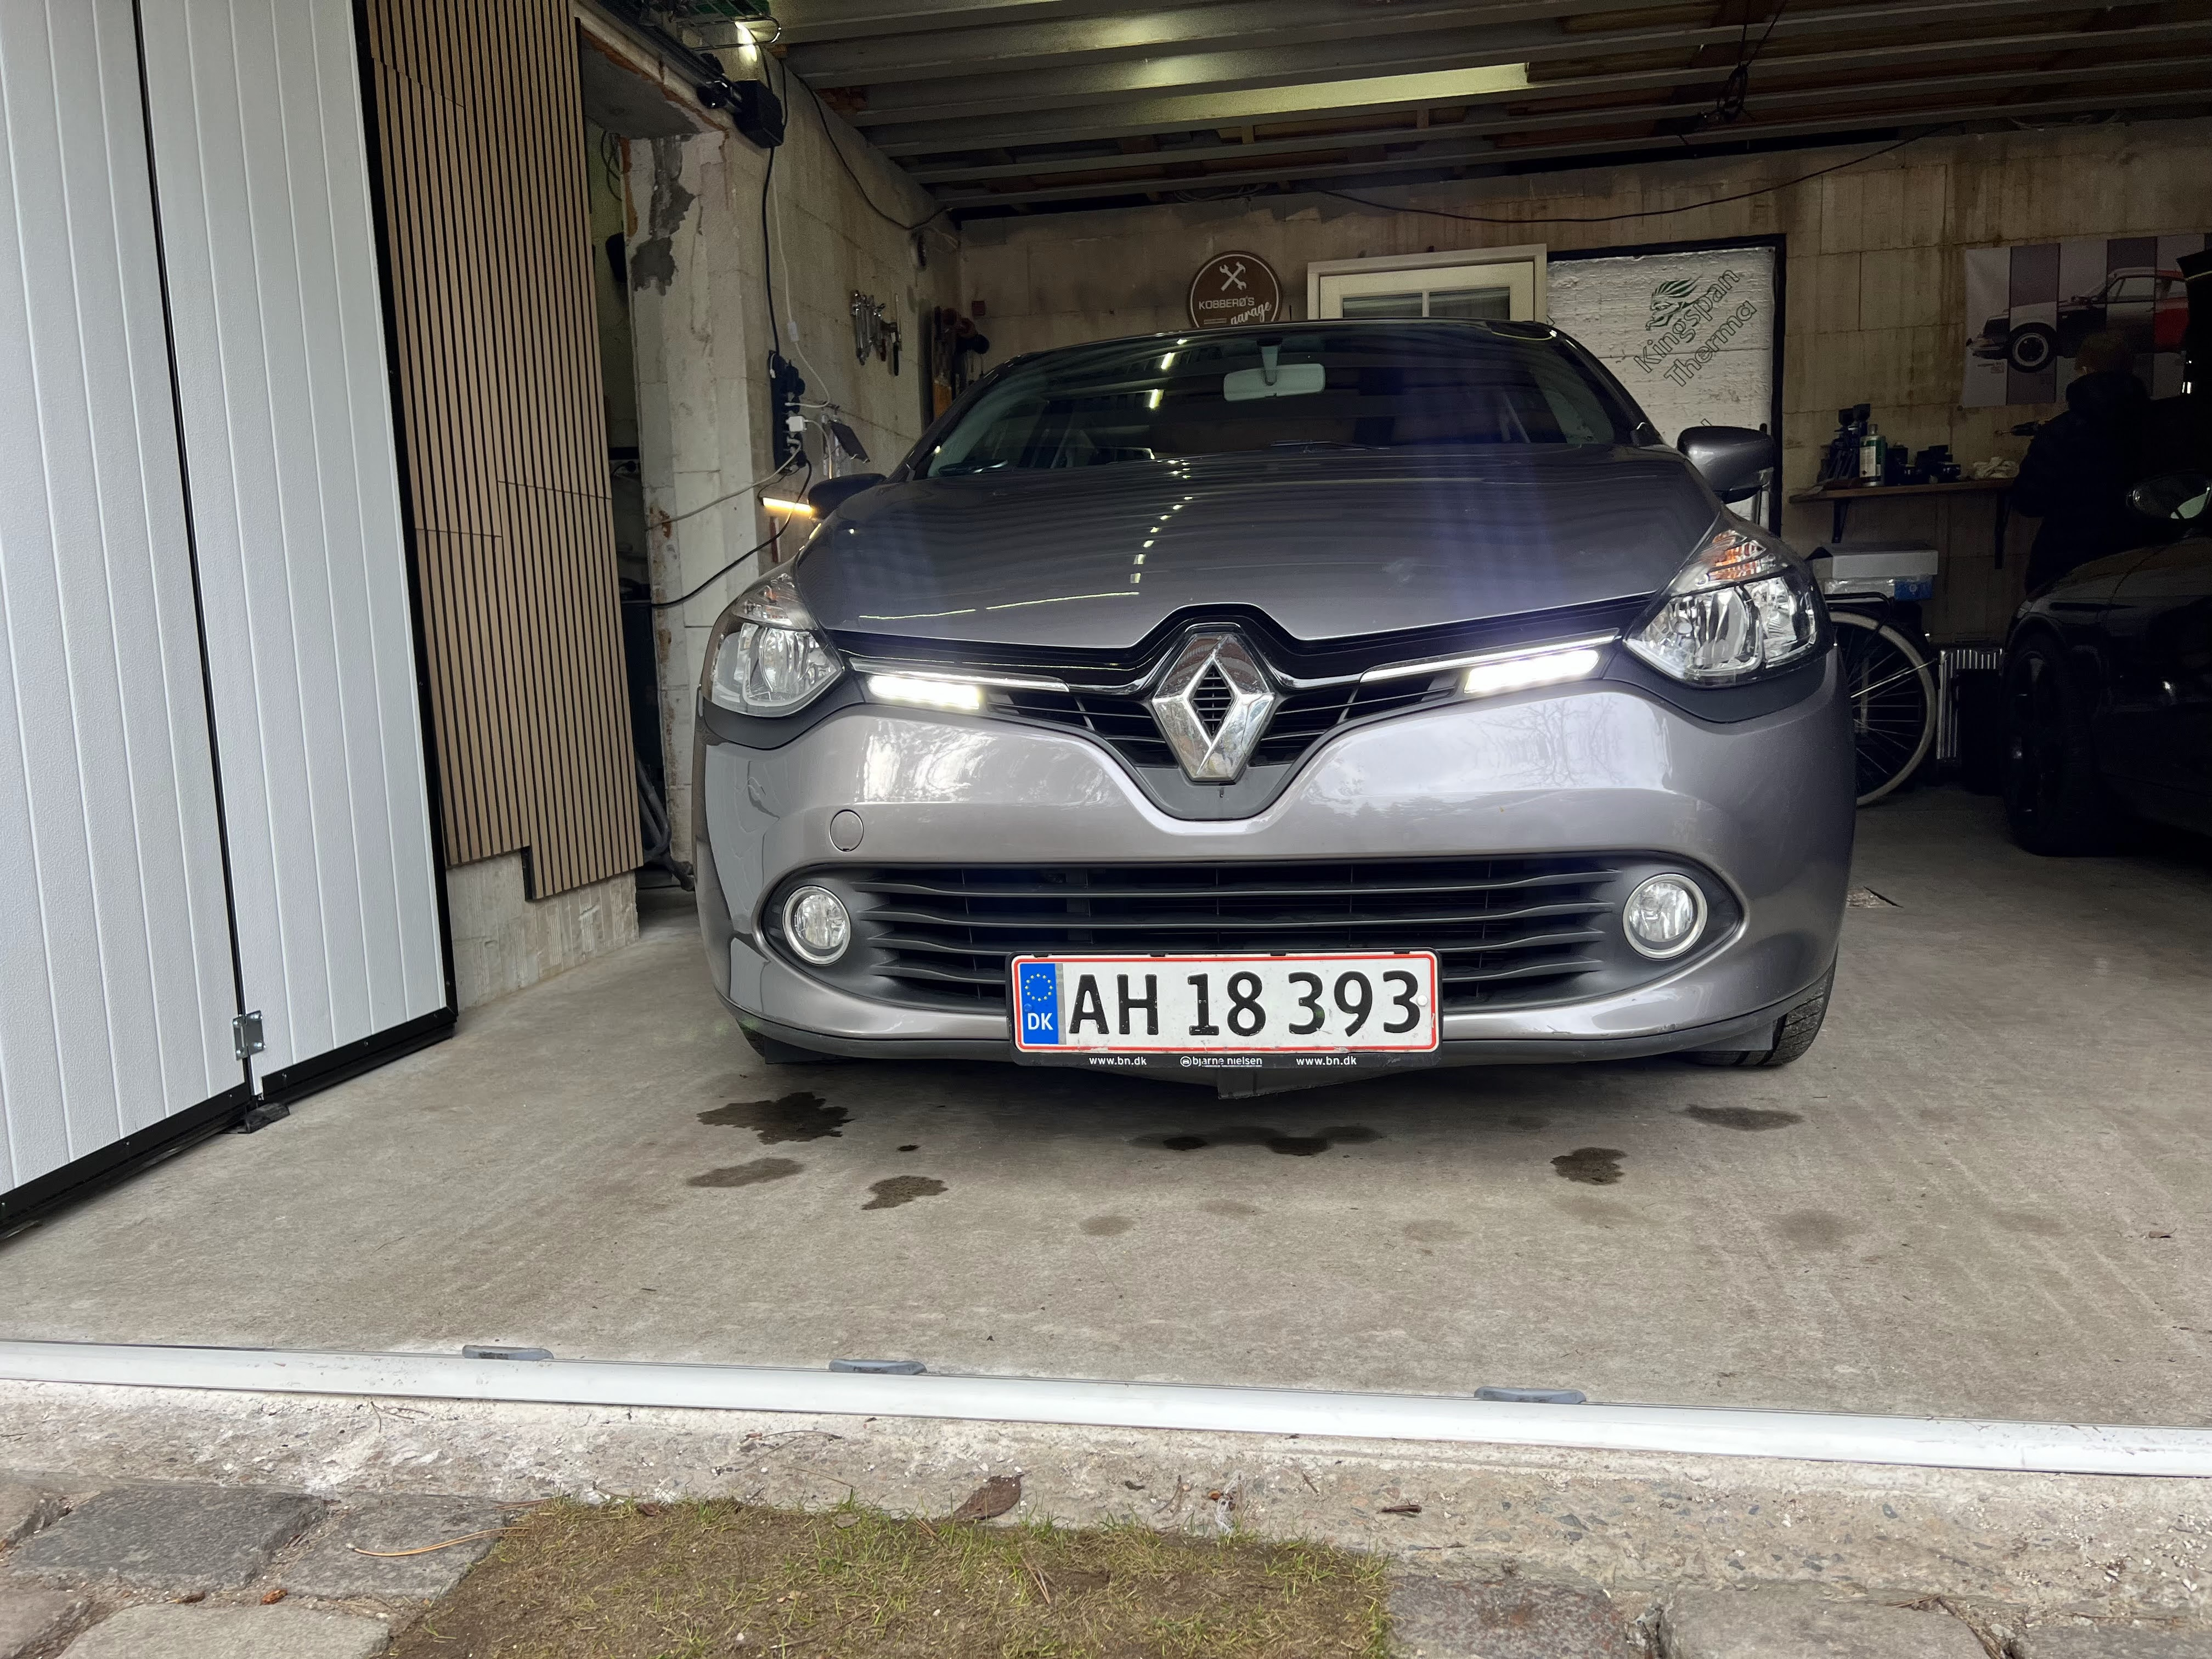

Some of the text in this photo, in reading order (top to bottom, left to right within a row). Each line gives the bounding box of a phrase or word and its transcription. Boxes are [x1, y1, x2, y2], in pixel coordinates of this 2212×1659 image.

[1633, 269, 1740, 374] Kingspan
[1663, 300, 1757, 387] Therma
[1068, 970, 1420, 1037] AH 18 393
[1027, 1012, 1054, 1031] DK
[1088, 1056, 1147, 1065] www.bn.dk
[1192, 1056, 1263, 1066] bjarne nielsen
[1296, 1056, 1357, 1065] www.bn.dk
